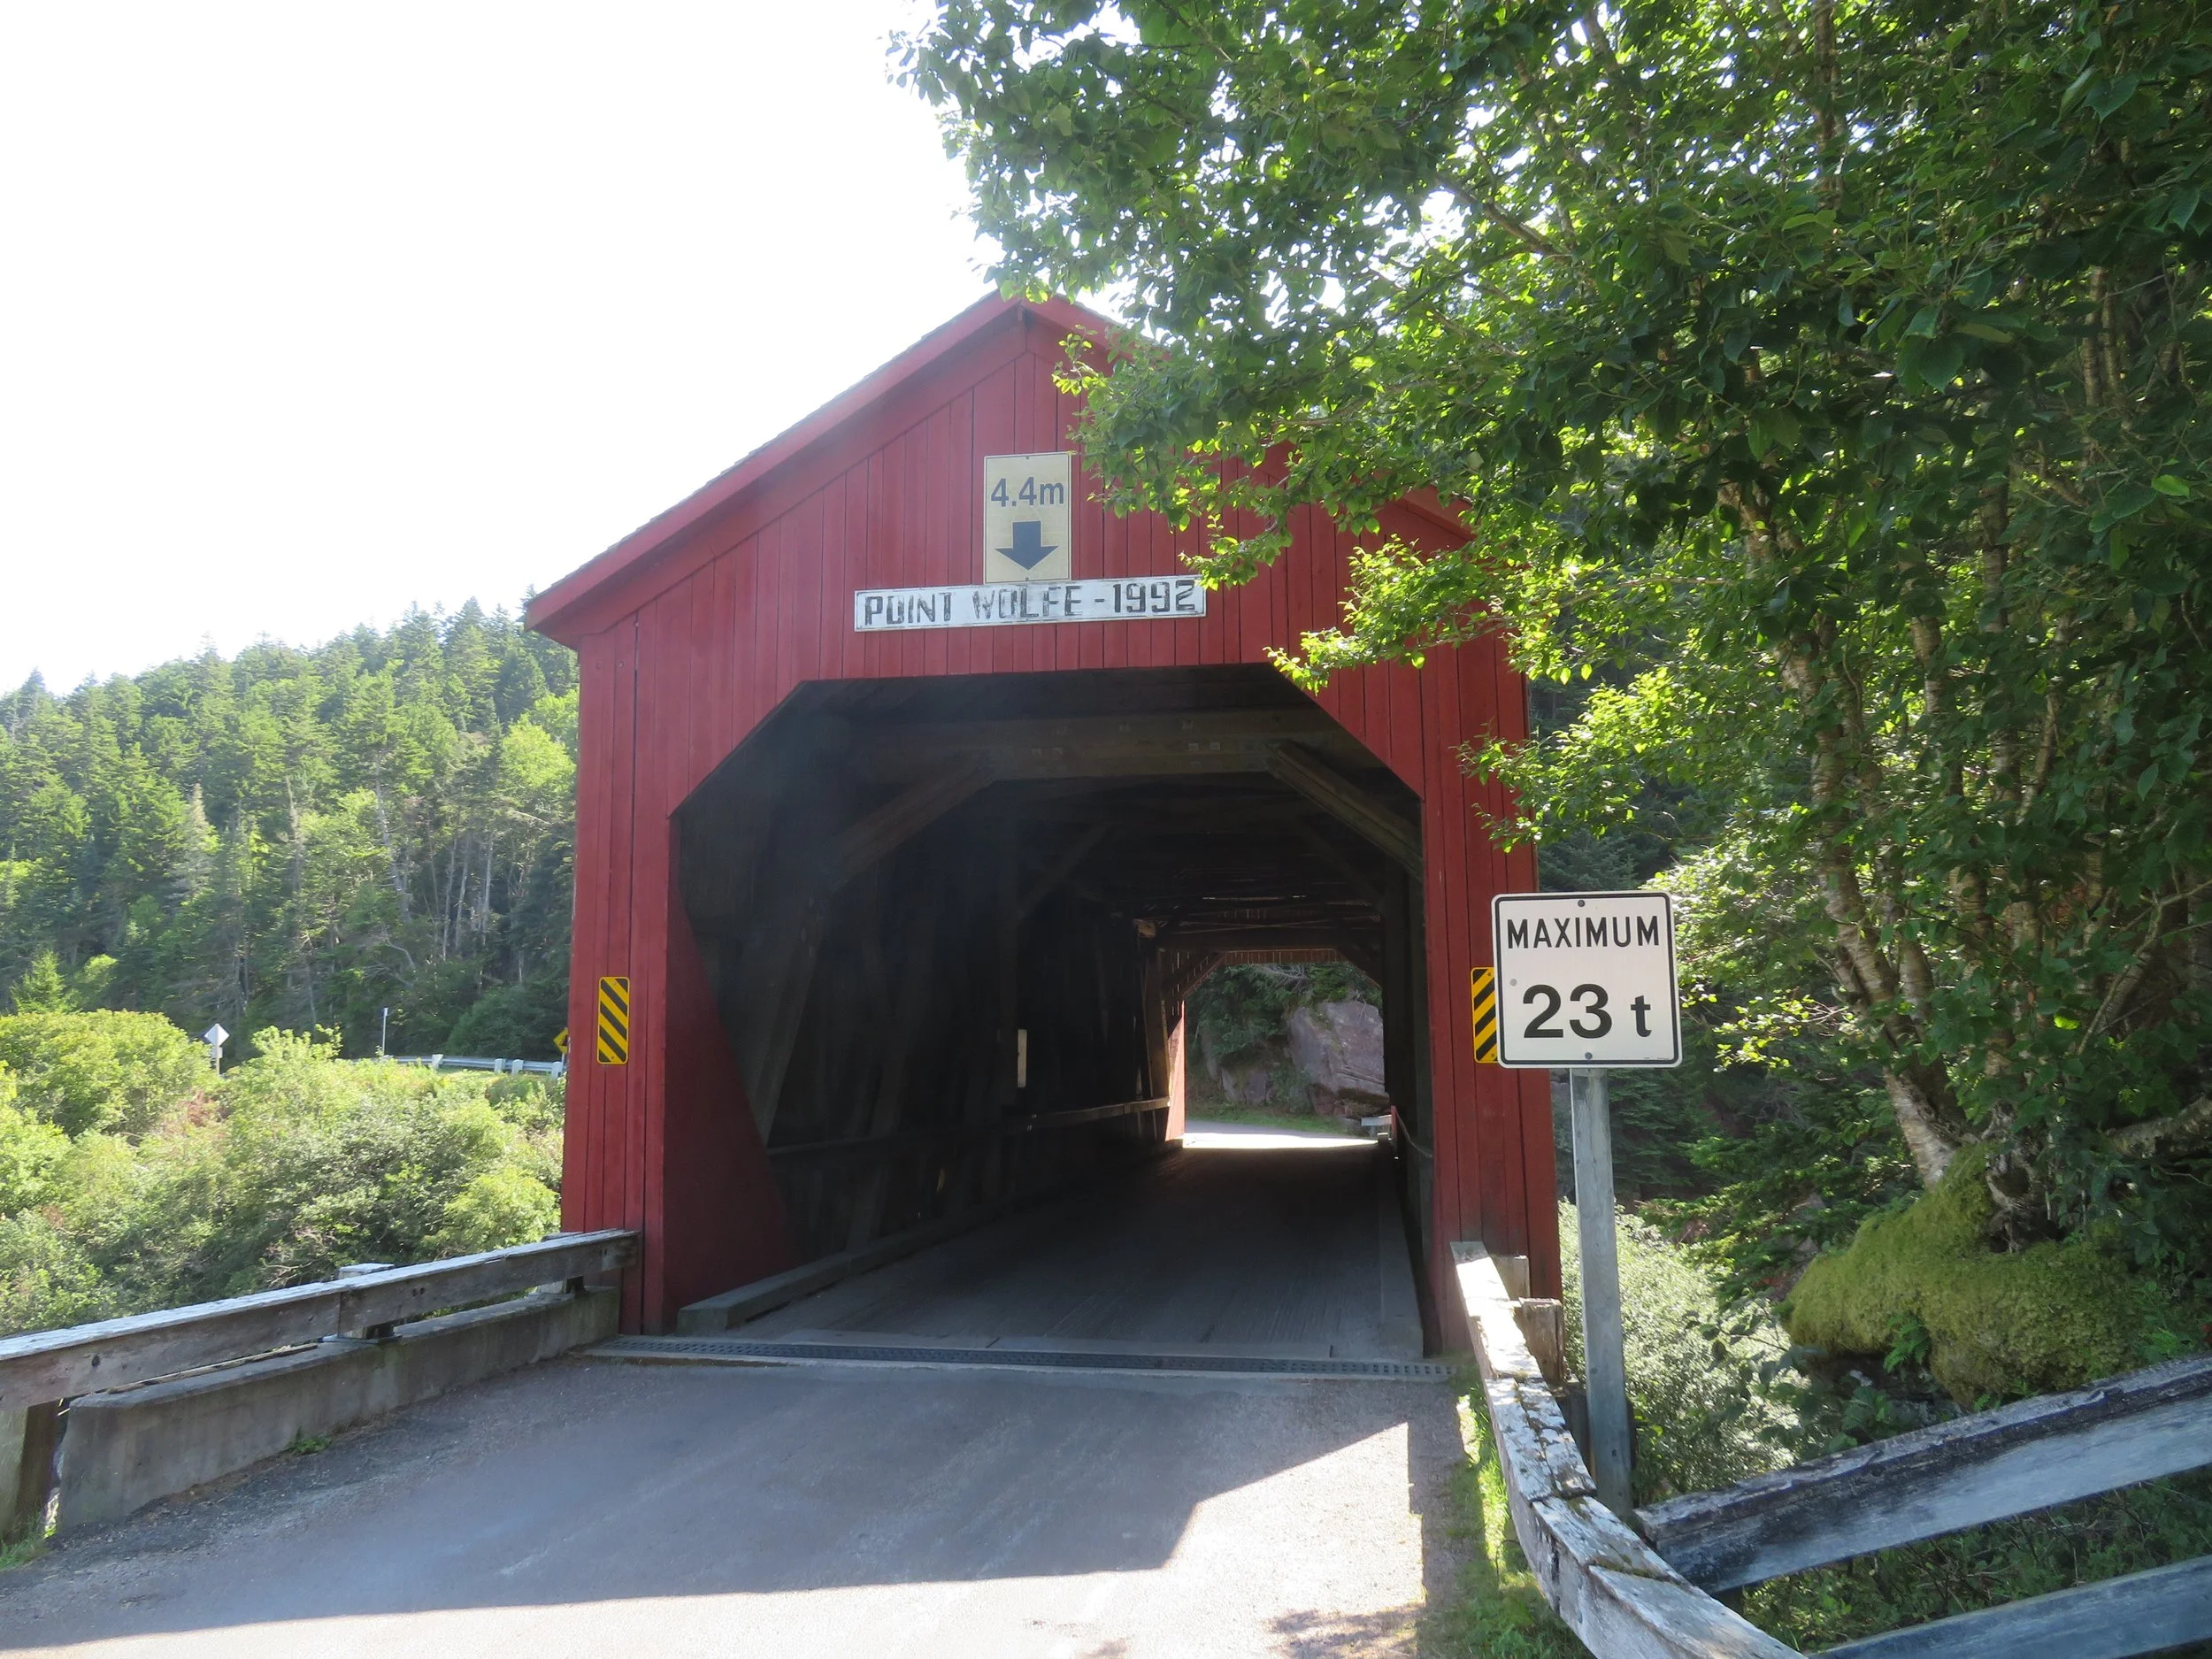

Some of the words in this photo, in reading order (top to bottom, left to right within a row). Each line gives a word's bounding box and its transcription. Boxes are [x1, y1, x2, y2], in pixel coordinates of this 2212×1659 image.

[990, 476, 1064, 507] 4.4m
[864, 592, 955, 626] POINT
[972, 585, 1084, 619] WOLFE
[1507, 915, 1659, 949] MAXIMUM
[1522, 983, 1613, 1040] 23
[1630, 995, 1653, 1038] t
